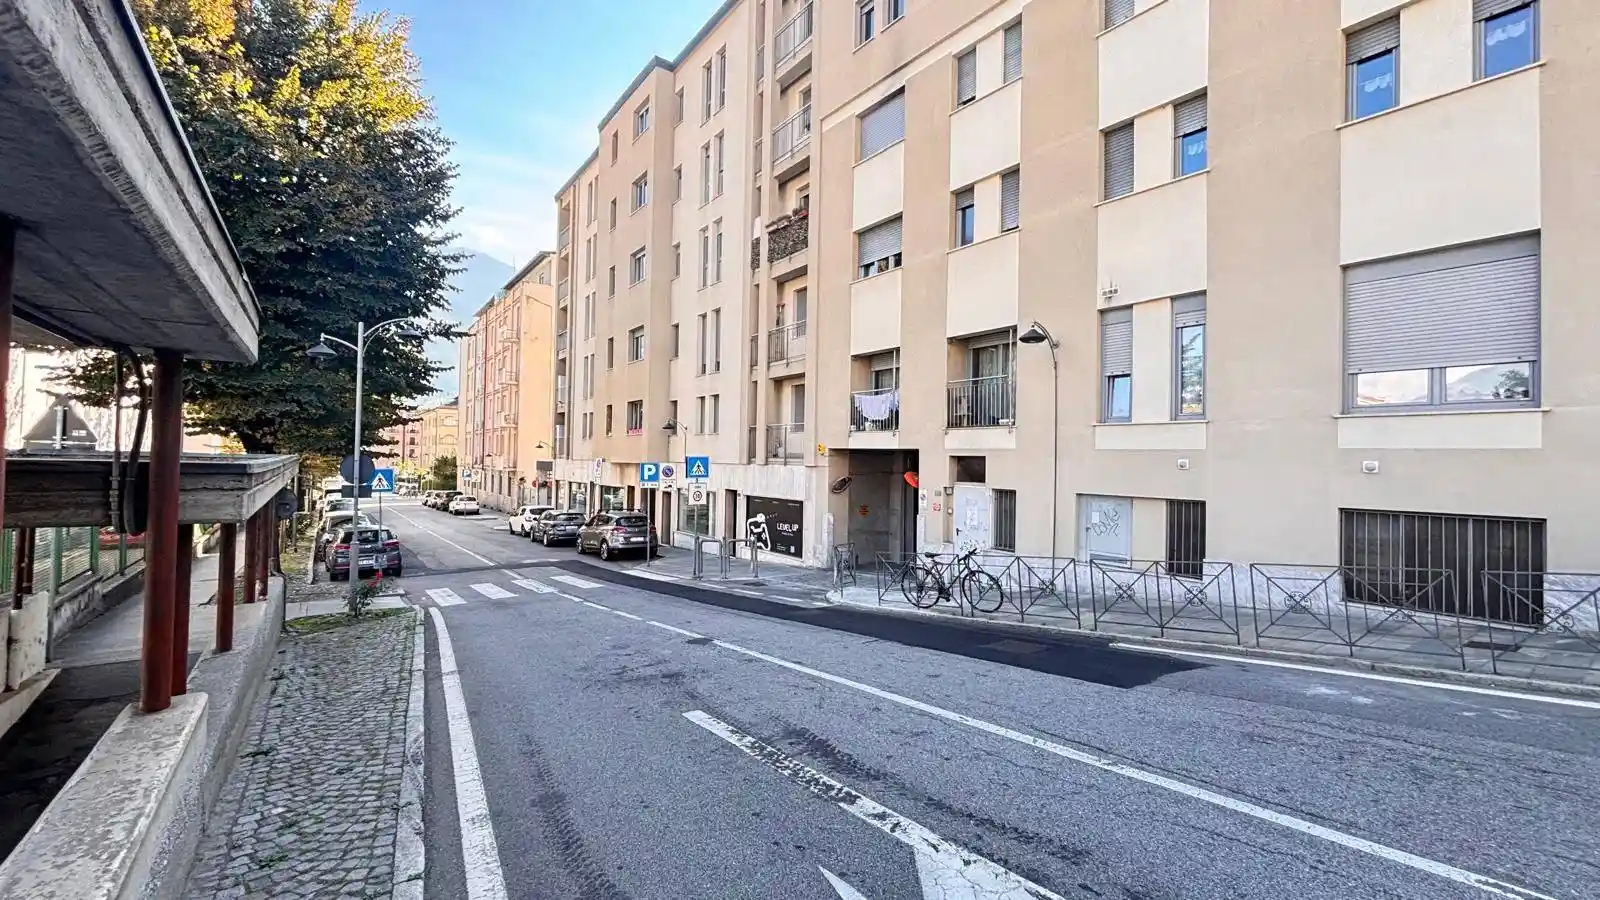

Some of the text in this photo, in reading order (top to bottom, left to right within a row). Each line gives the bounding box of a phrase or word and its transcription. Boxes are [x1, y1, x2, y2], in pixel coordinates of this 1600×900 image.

[643, 464, 656, 480] P
[776, 522, 799, 532] LEVEL UP
